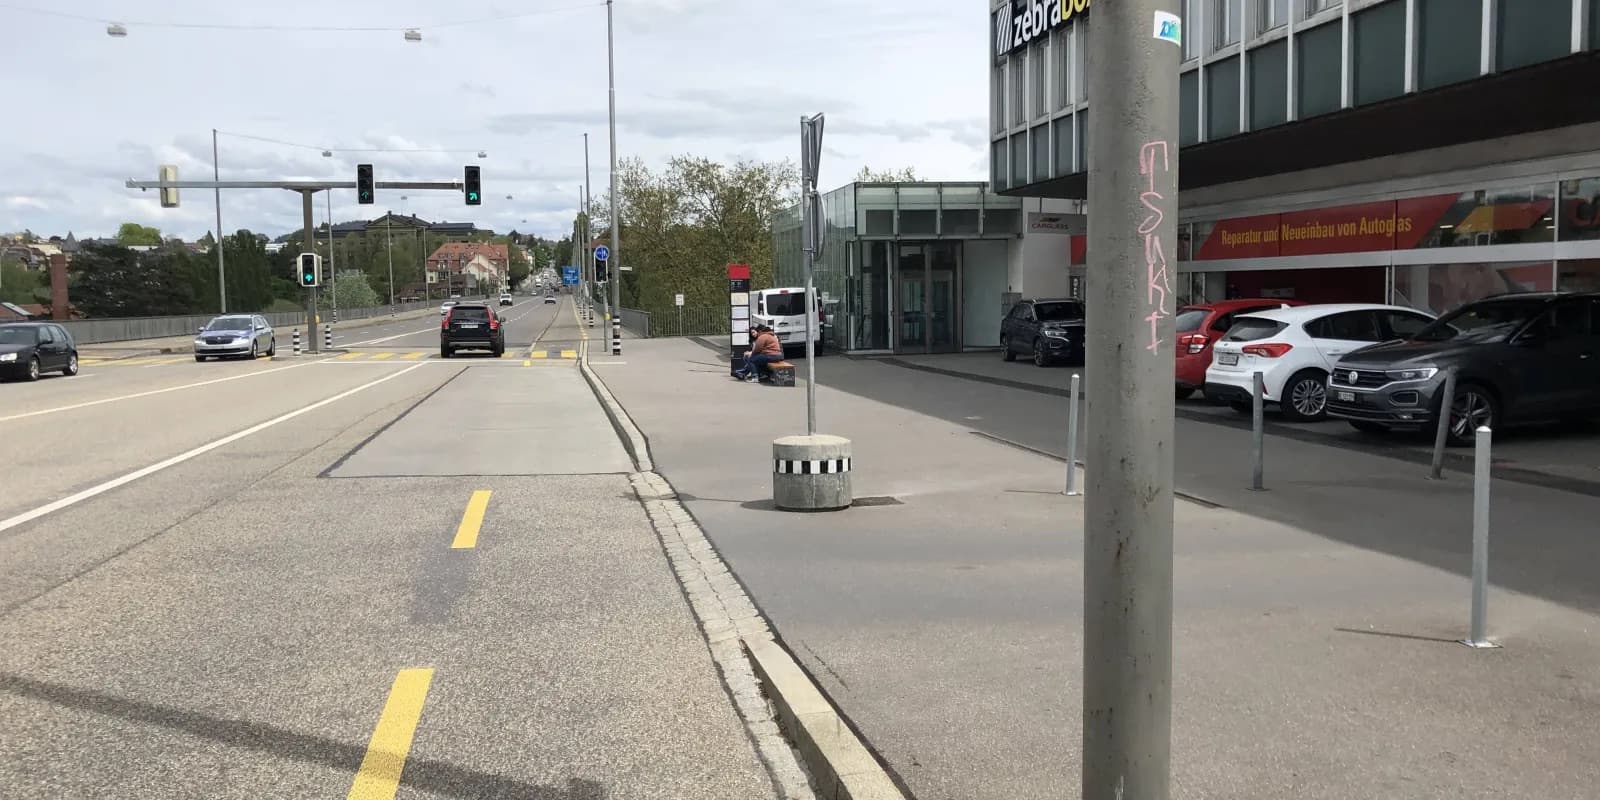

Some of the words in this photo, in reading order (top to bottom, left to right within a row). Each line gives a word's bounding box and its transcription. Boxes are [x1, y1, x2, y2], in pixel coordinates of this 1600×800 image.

[1013, 0, 1090, 47] zebrab
[1221, 229, 1261, 248] Reparatur
[1264, 228, 1280, 242] und
[1281, 222, 1335, 241] Neueinbau
[1337, 222, 1356, 237] von
[1359, 213, 1412, 238] Autoglas
